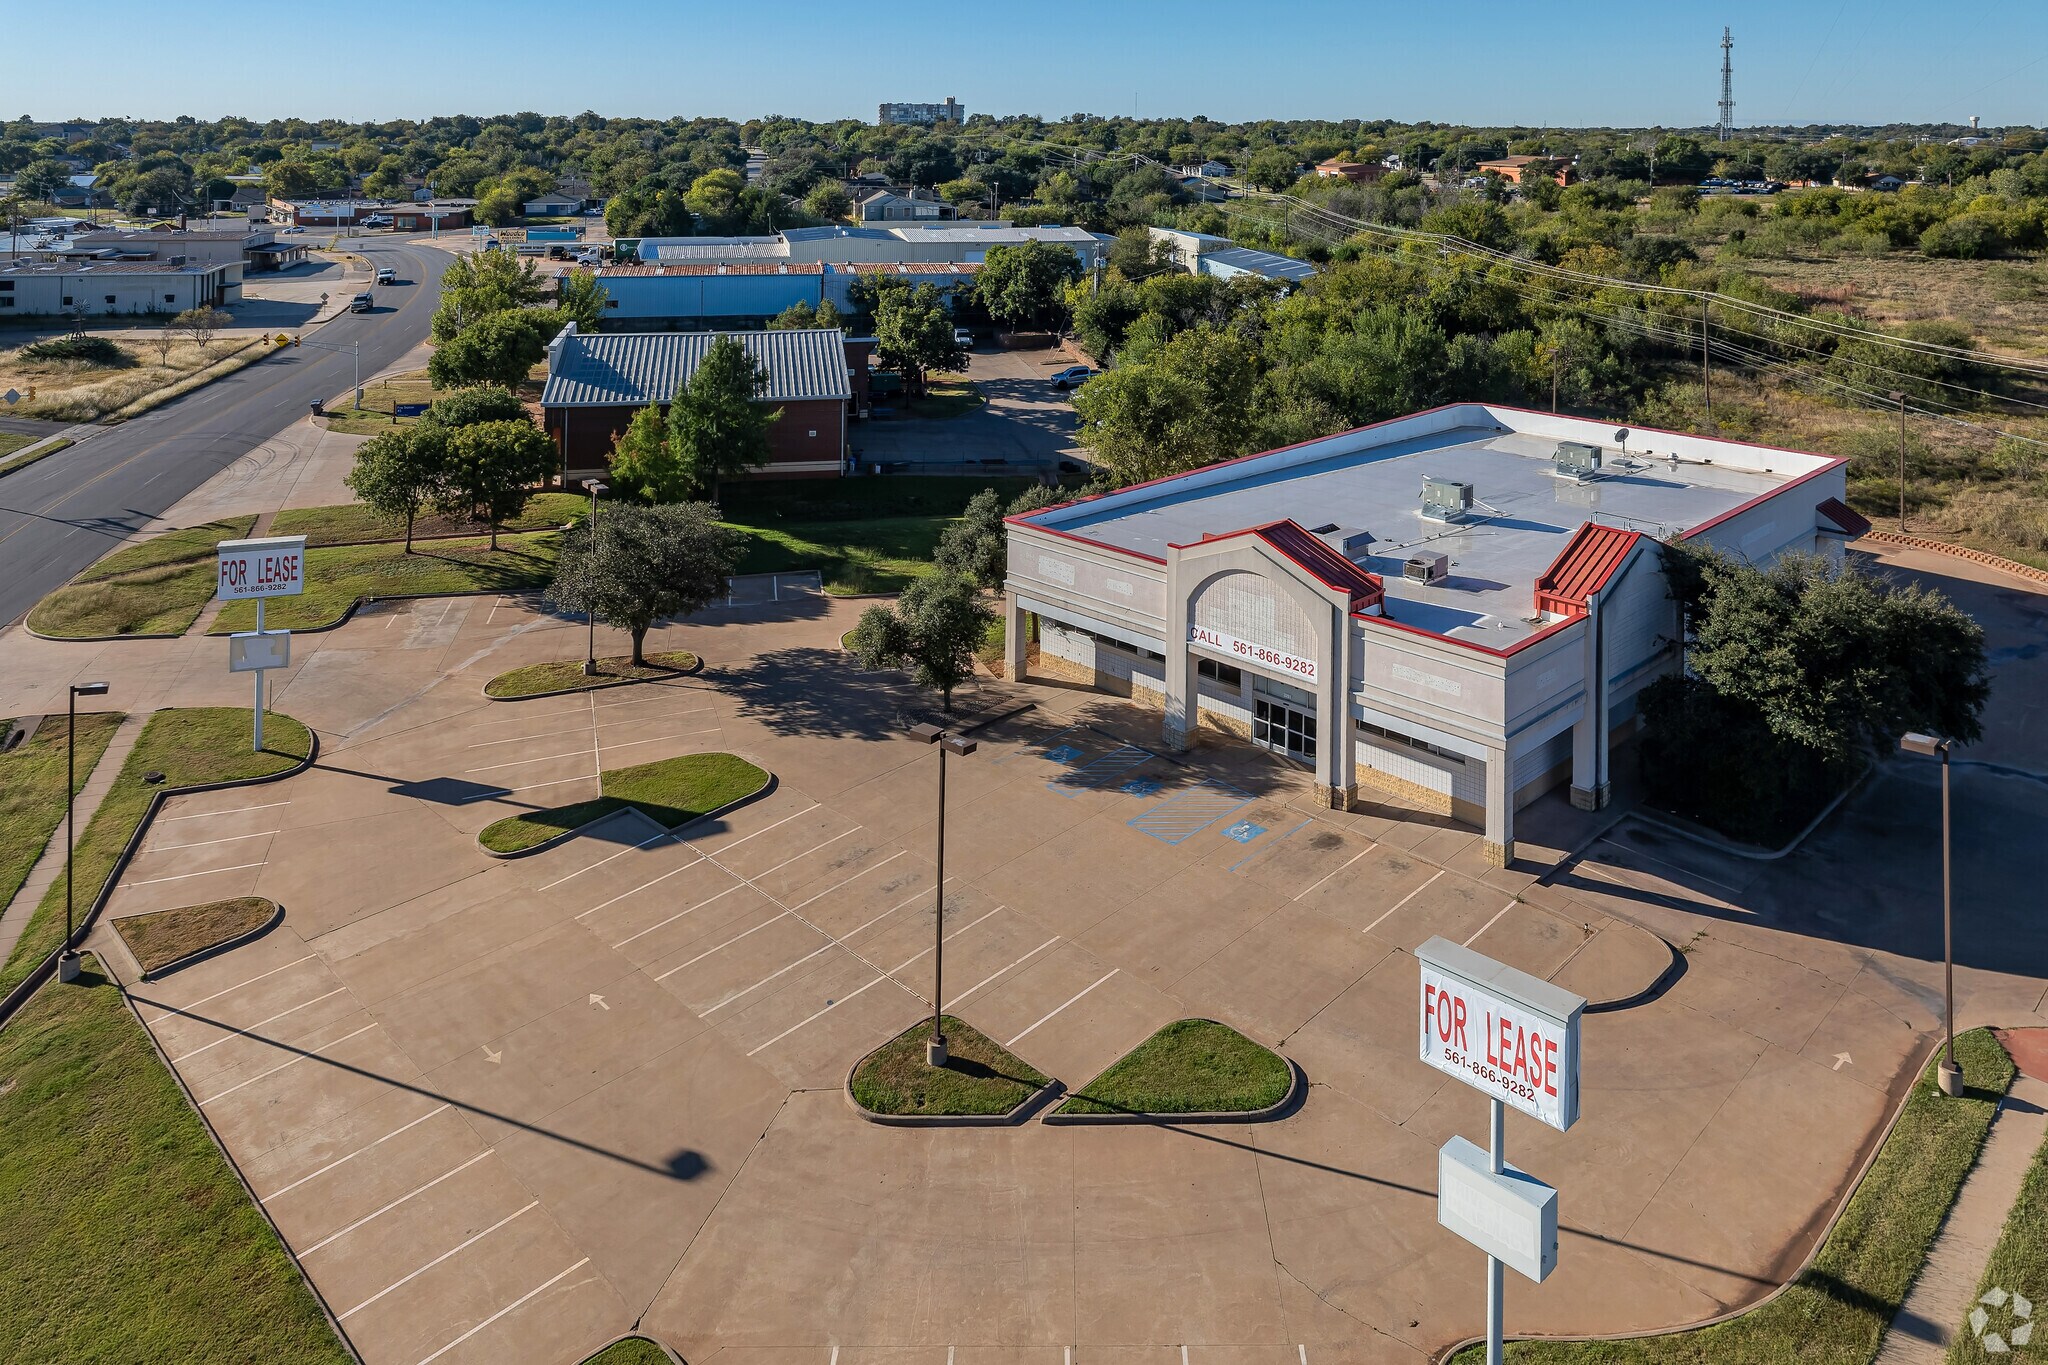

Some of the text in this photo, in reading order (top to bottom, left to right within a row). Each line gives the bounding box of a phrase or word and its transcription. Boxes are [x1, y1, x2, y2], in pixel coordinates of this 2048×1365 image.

[221, 556, 298, 586] FOR LEASE
[234, 583, 287, 594] 561-866-9282
[1190, 627, 1315, 676] CALL 561-866-9282
[1424, 982, 1558, 1098] FOR LEASE
[1444, 1047, 1536, 1102] 561-866-9282
